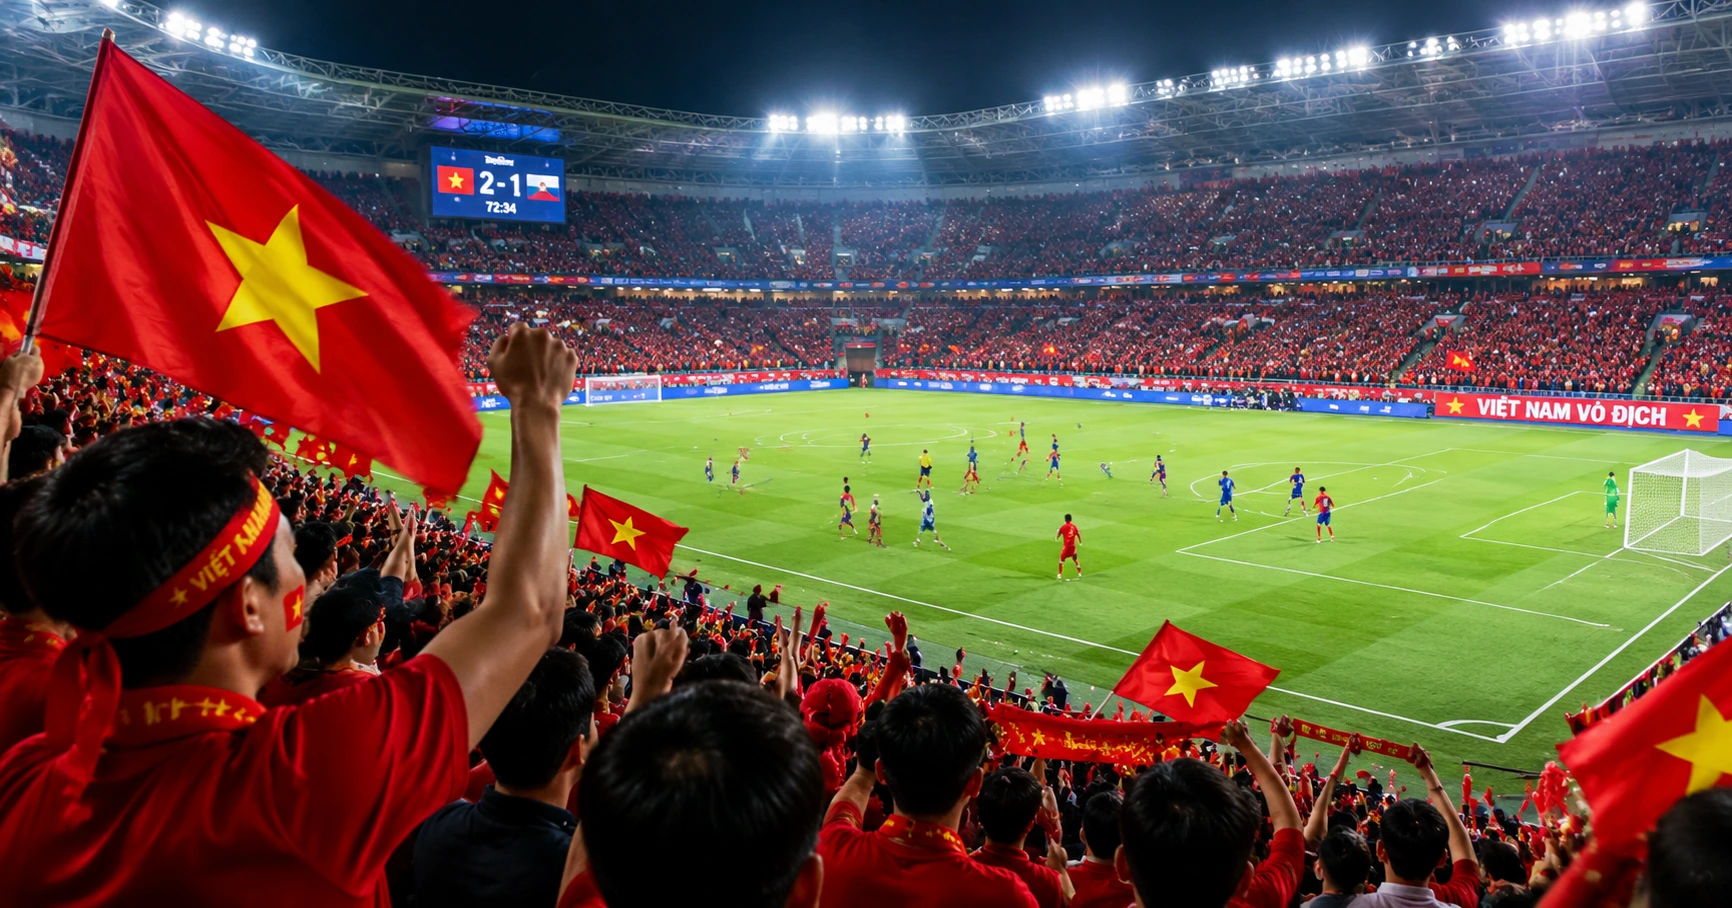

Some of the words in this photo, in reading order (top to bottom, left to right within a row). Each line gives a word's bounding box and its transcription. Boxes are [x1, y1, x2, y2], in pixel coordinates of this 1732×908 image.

[485, 201, 517, 214] 72:34
[1525, 400, 1571, 420] NAM
[1611, 405, 1667, 428] ĐỊCH
